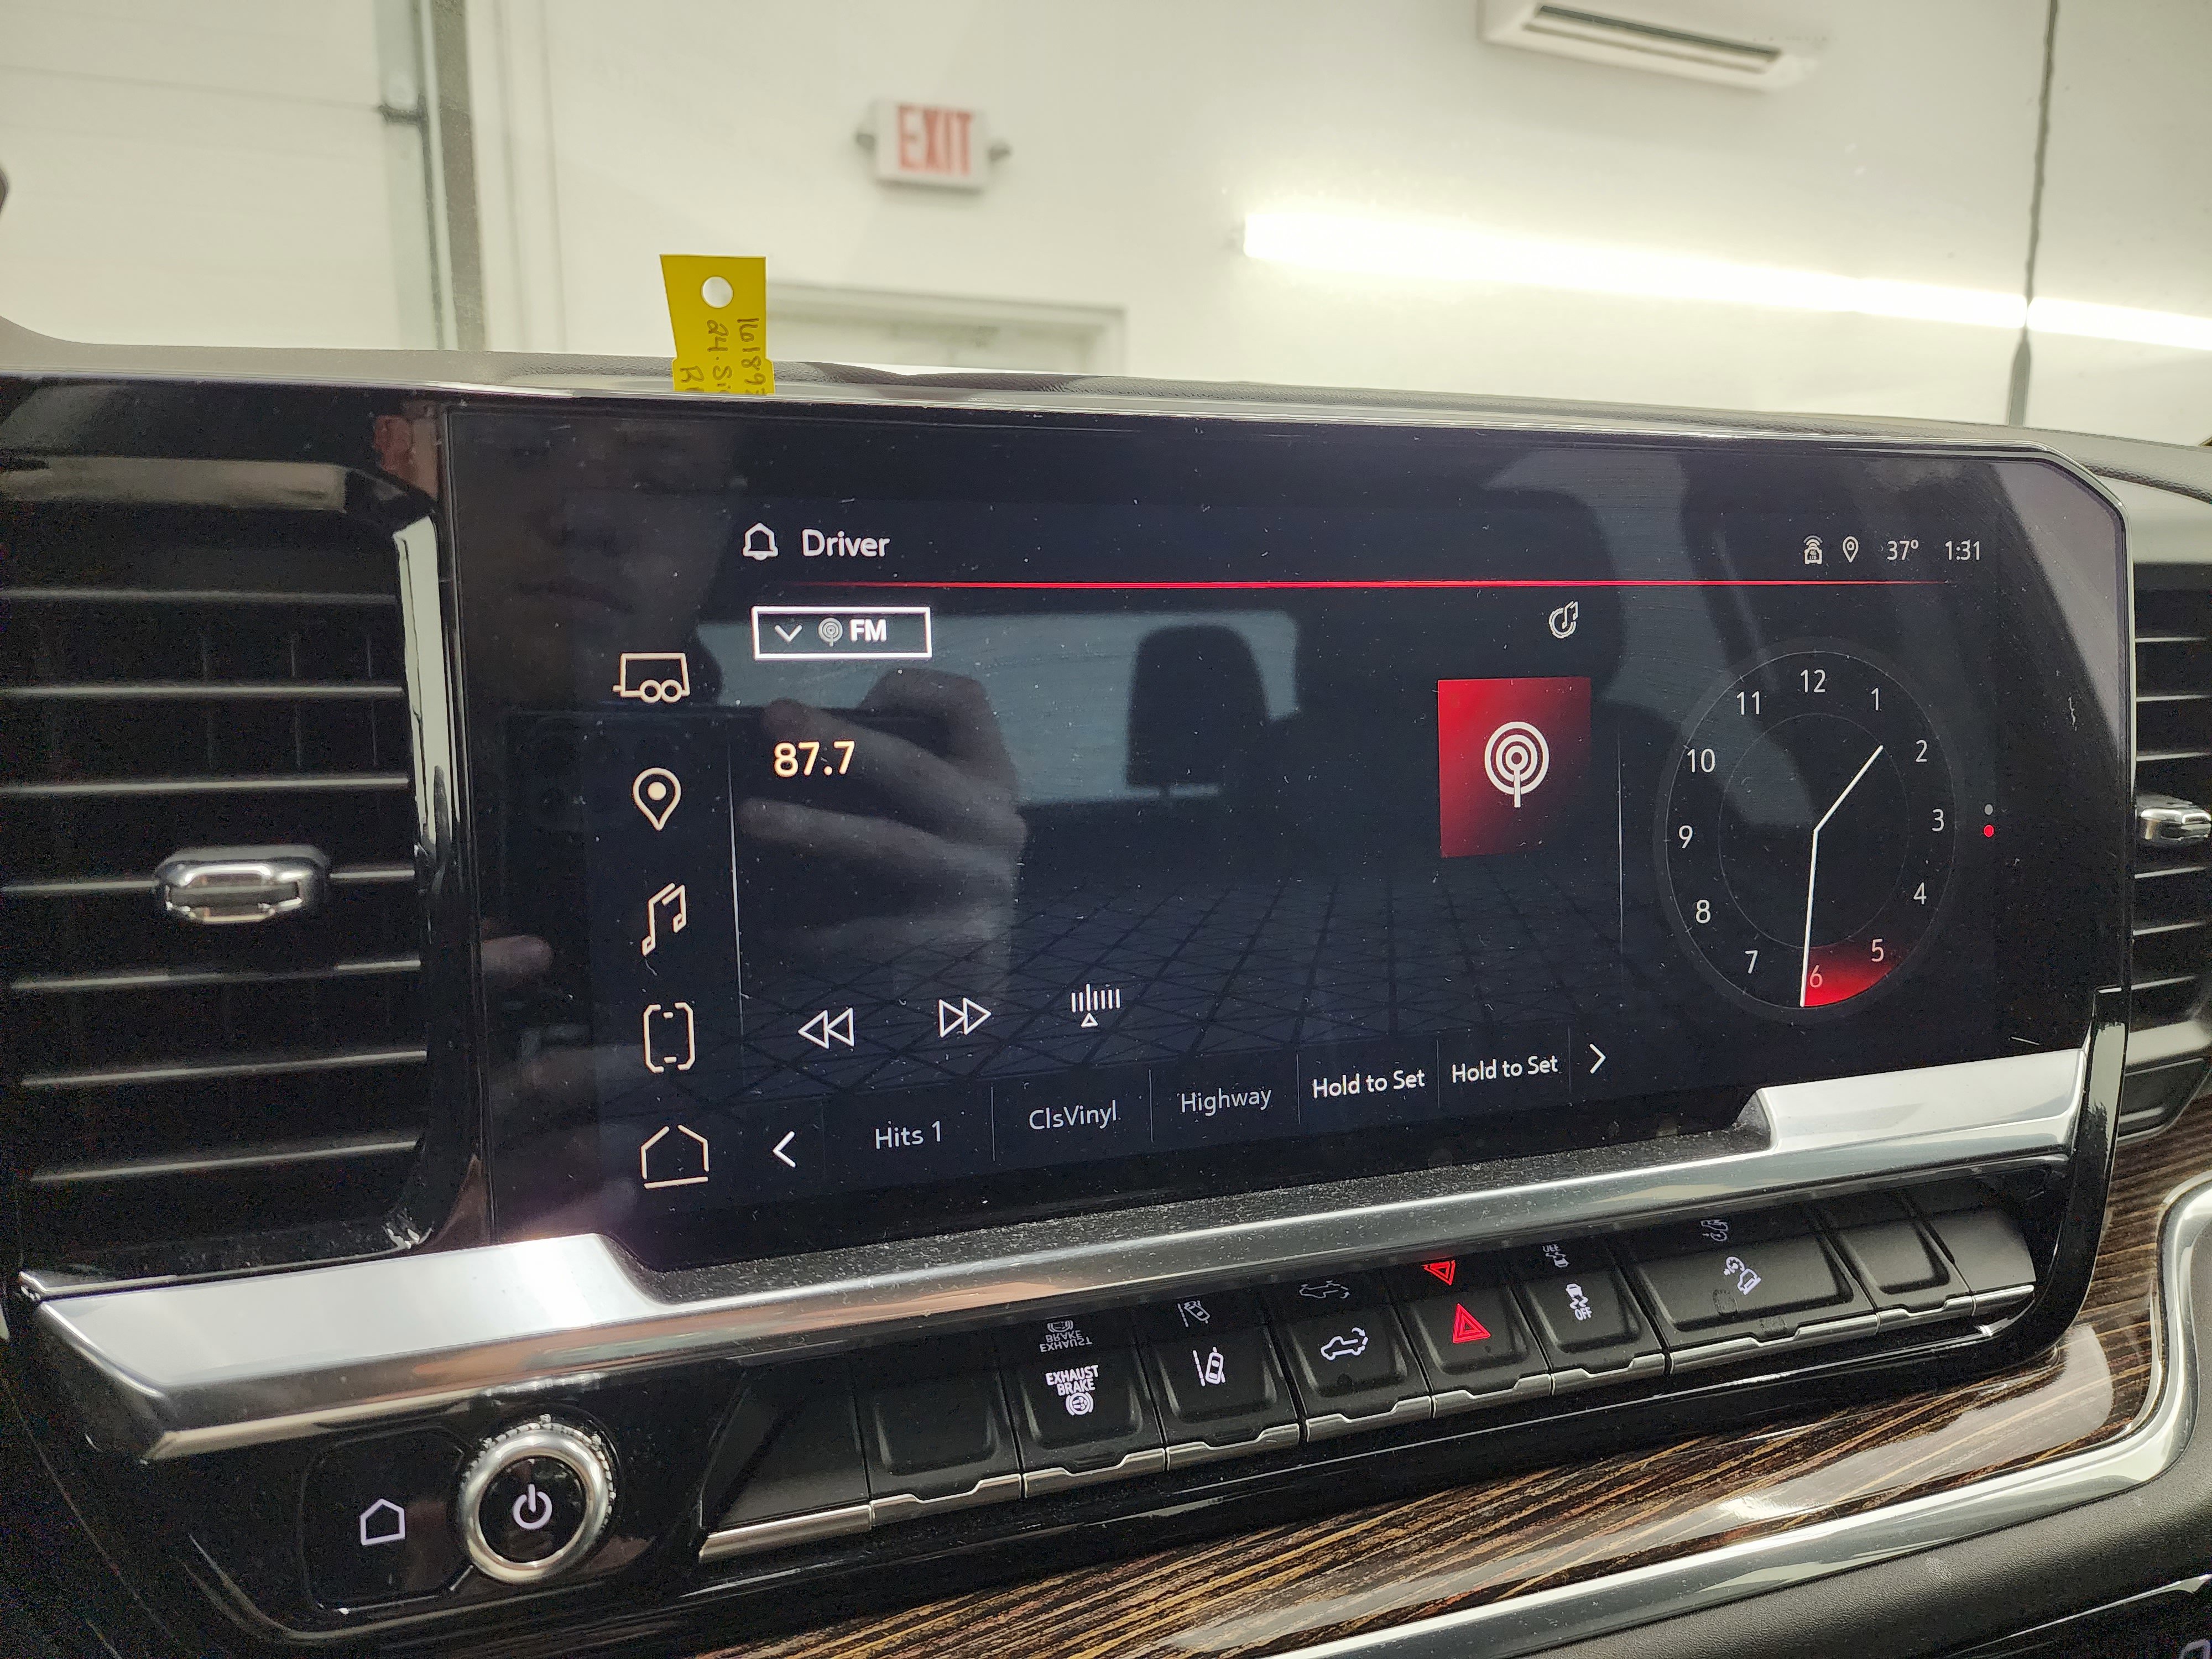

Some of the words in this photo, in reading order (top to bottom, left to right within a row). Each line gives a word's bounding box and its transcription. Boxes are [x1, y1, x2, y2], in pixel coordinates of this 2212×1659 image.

[896, 103, 972, 175] EXIT
[737, 317, 767, 395] 16189
[802, 528, 890, 557] Driver
[1945, 539, 1980, 561] 1:31
[850, 619, 887, 642] FM
[1800, 669, 1825, 693] 12
[1736, 691, 1761, 716] 11
[1871, 687, 1879, 711] 1
[774, 740, 855, 777] 87.7
[1687, 748, 1716, 773] 10
[1915, 739, 1928, 763] 2
[1932, 808, 1944, 832] 3
[1678, 825, 1693, 849] 9
[1913, 882, 1927, 905] 4
[1695, 899, 1711, 924] 8
[1745, 950, 1758, 974] 7
[1871, 938, 1884, 962] 5
[1809, 964, 1823, 988] 6
[1452, 1055, 1497, 1083] Hold
[1502, 1060, 1523, 1078] to
[1527, 1055, 1558, 1074] Set
[1313, 1073, 1360, 1098] Hold
[1365, 1074, 1387, 1093] to
[1393, 1069, 1425, 1089] Set
[1180, 1087, 1272, 1117] Highway
[1029, 1099, 1117, 1130] ClsVinyl
[875, 1126, 924, 1150] Hits
[931, 1120, 941, 1142] 1
[1574, 1306, 1592, 1321] OFF
[1045, 1365, 1098, 1386] EXHAUST
[1057, 1379, 1095, 1396] BRAKE
